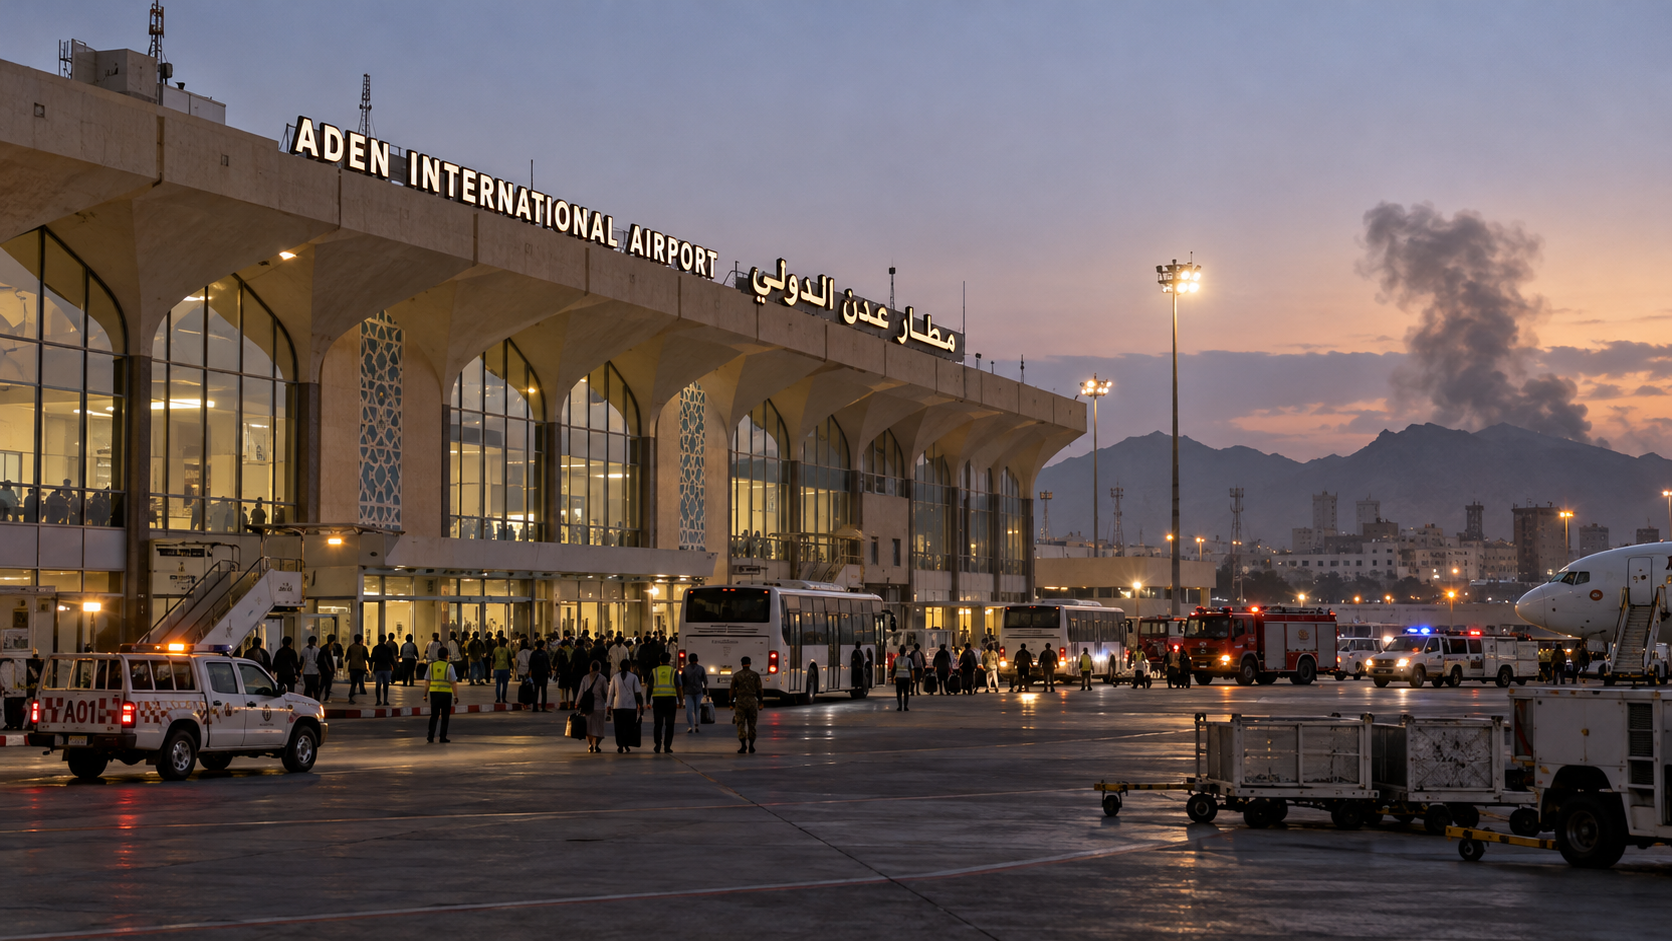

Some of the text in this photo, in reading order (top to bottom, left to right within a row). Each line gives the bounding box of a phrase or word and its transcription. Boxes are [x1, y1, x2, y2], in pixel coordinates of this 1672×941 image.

[292, 117, 719, 279] ADEN INTERNATIONAL AIRPORT
[752, 258, 957, 354] مطار عدن الدولي
[62, 699, 97, 725] A01
